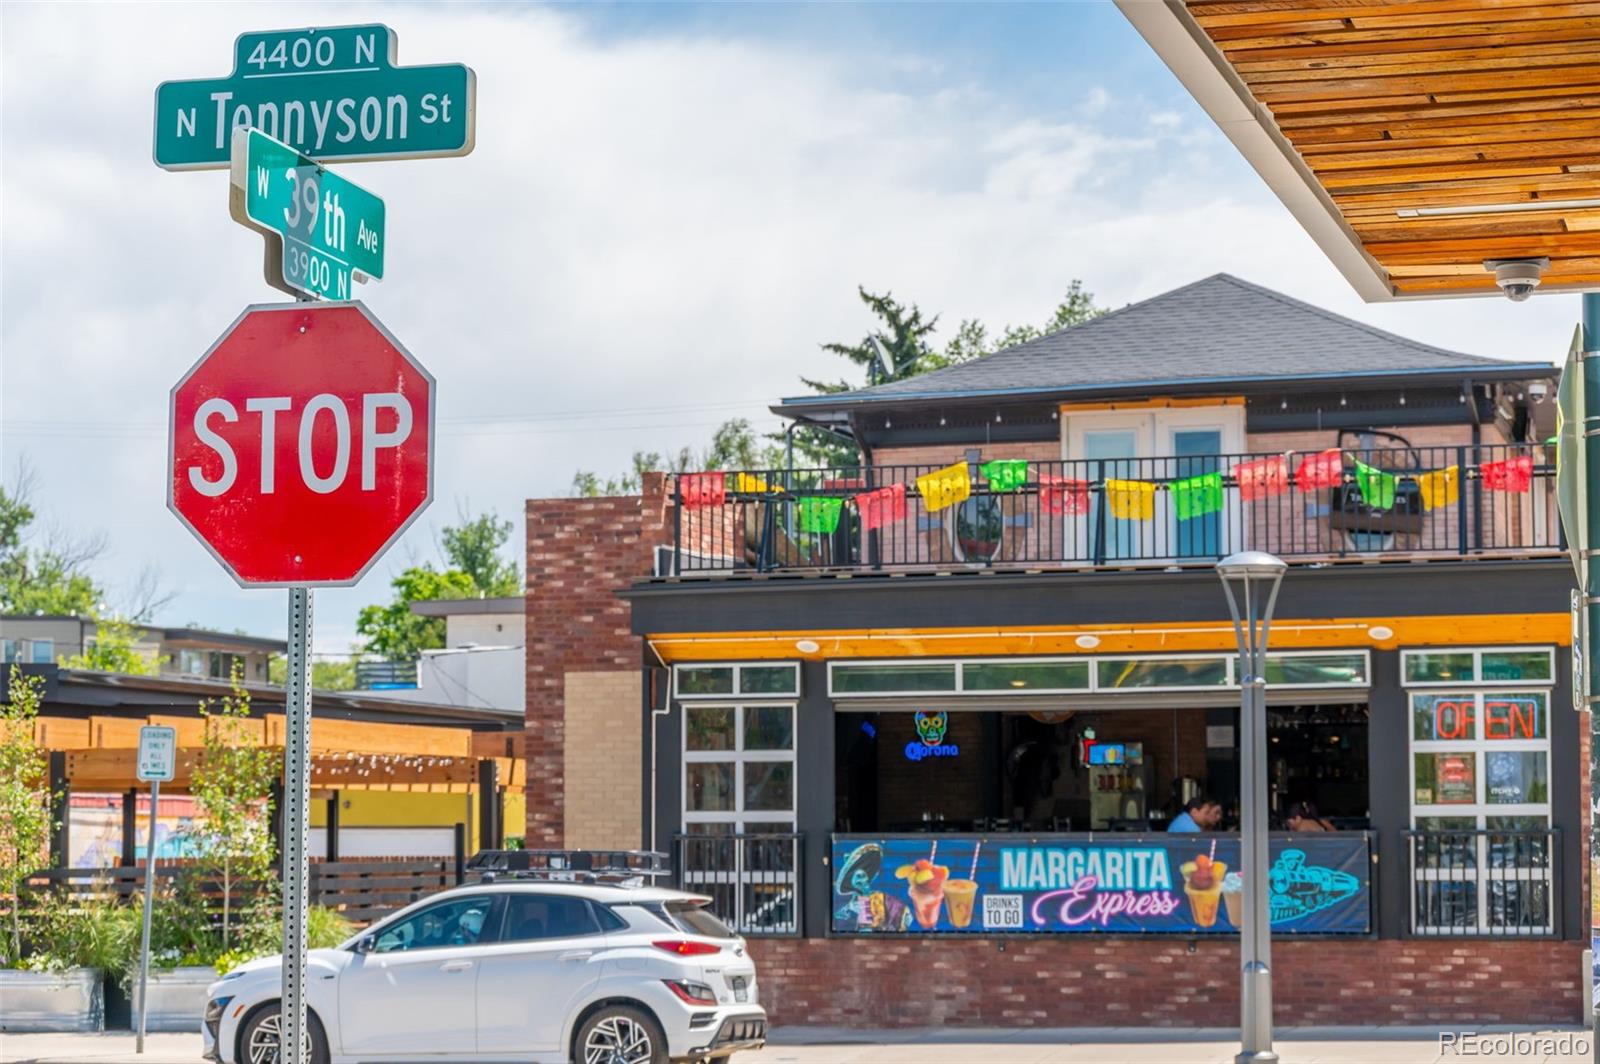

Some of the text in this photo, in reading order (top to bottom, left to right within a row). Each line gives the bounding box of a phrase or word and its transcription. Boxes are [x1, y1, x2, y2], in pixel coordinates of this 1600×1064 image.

[247, 34, 375, 70] 4400 N
[176, 91, 452, 150] N Tennyson St
[257, 164, 378, 254] W 39th Ave
[289, 246, 347, 299] 3900 N
[188, 392, 414, 497] STOP
[1436, 702, 1535, 739] OPEN
[905, 742, 959, 760] Corona
[1002, 850, 1170, 889] MARGARITA
[986, 897, 1020, 909] DRINKS
[986, 910, 1020, 925] TO GO
[1031, 875, 1179, 926] Express
